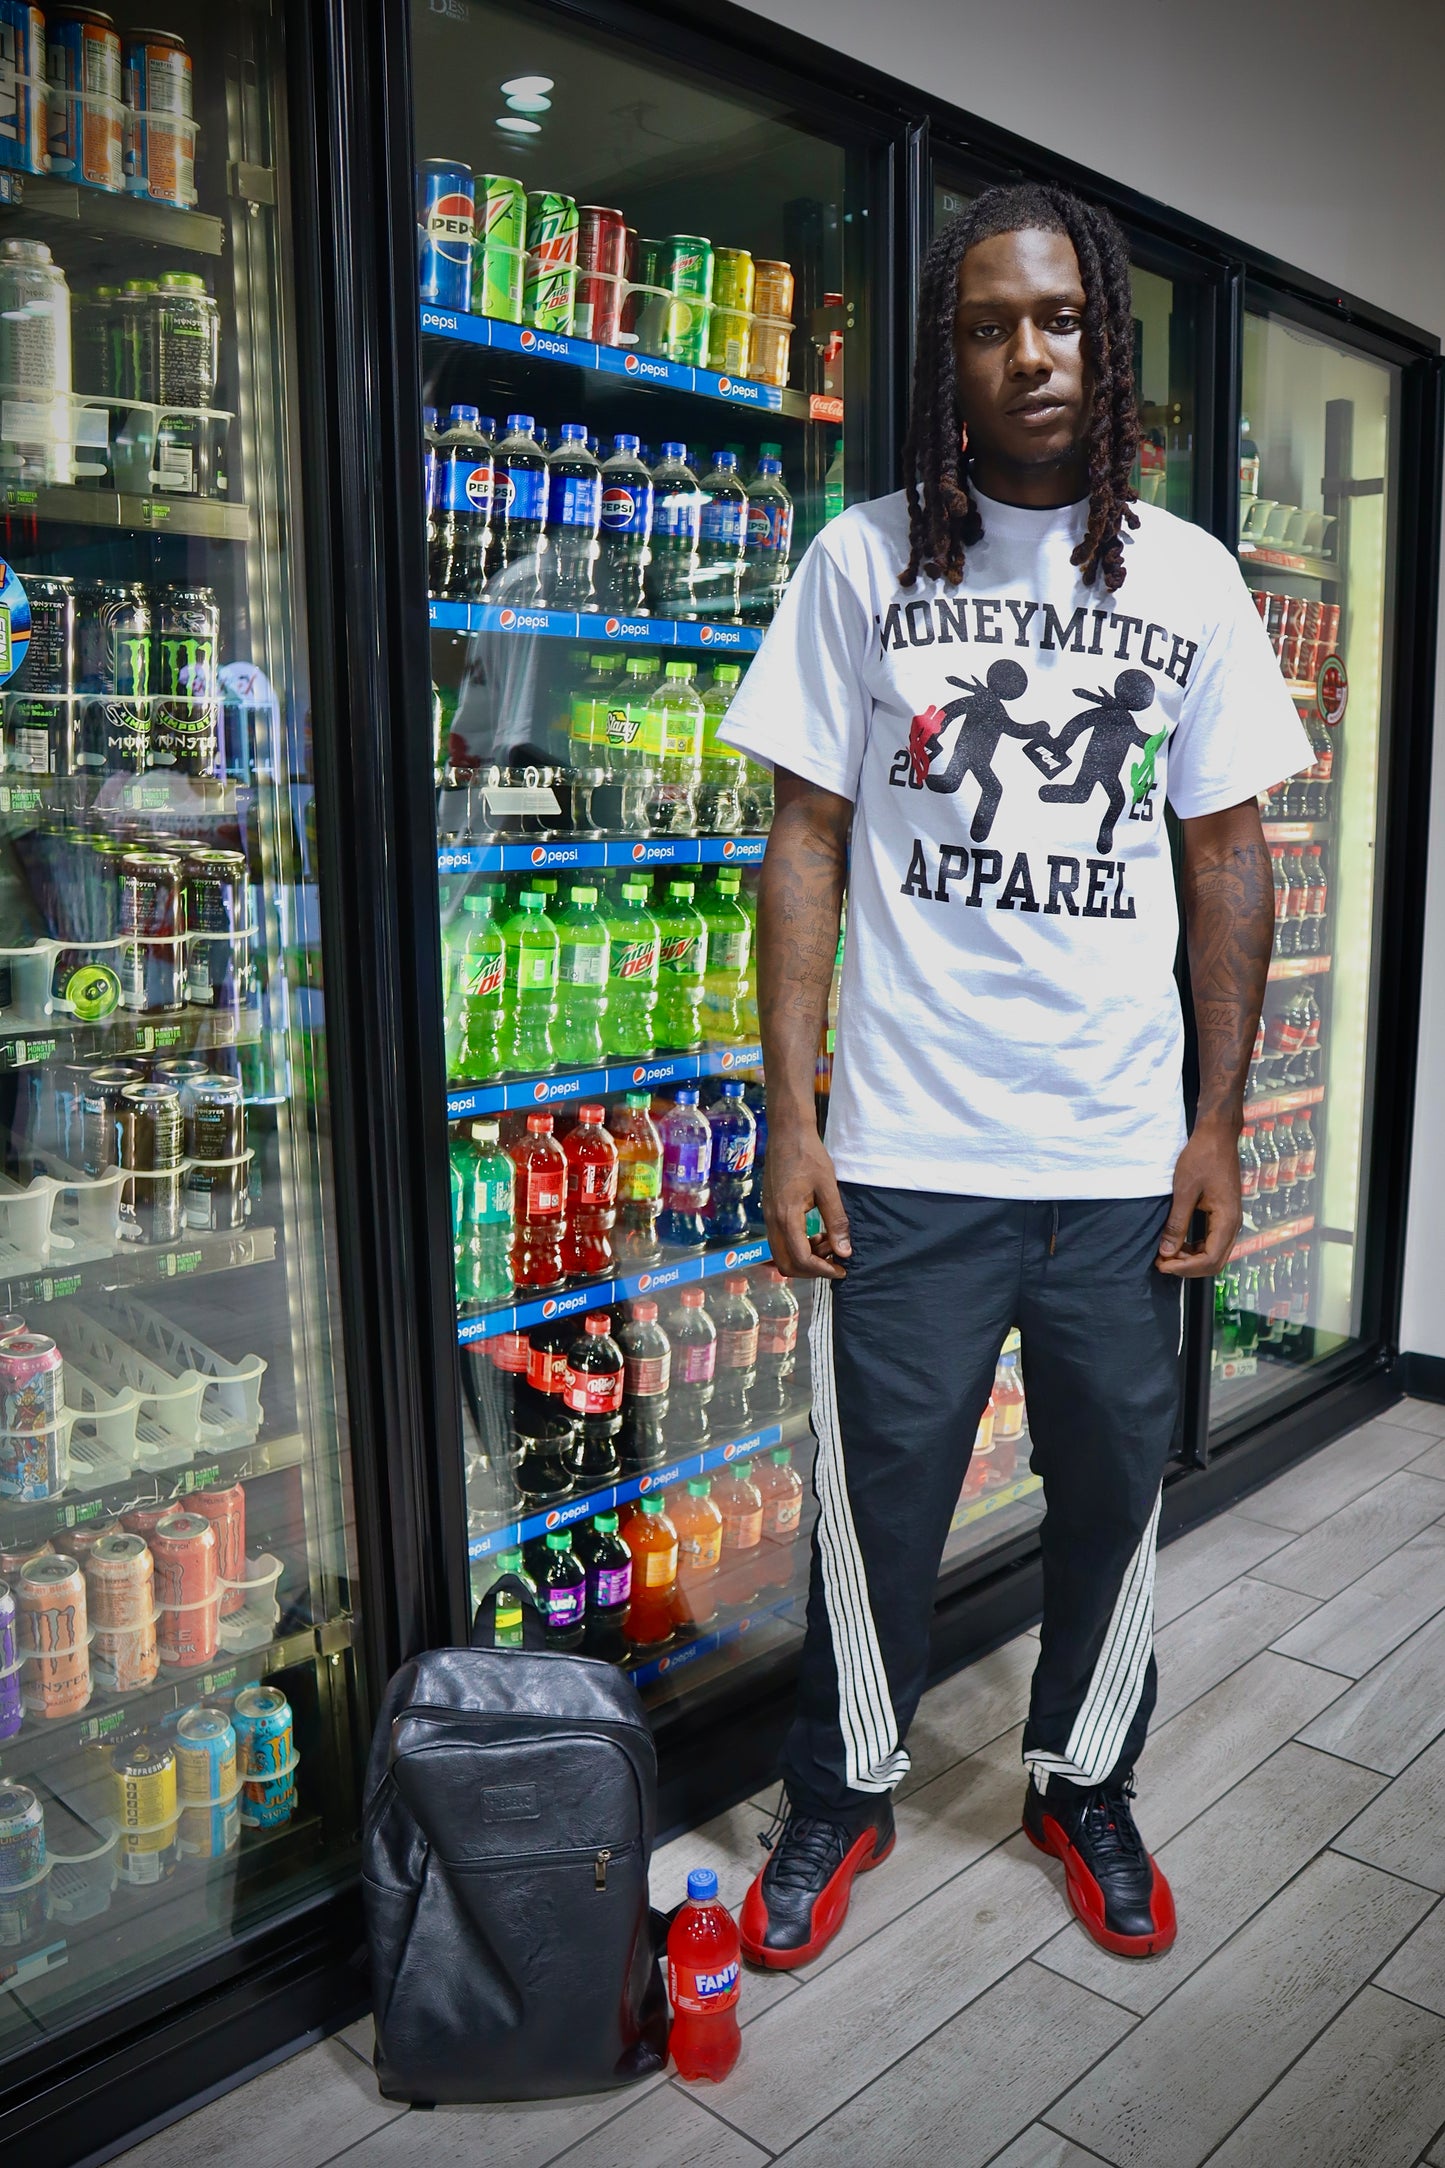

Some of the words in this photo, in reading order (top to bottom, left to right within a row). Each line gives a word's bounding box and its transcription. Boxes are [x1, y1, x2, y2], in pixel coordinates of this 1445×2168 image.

[422, 312, 458, 330] pepsi
[537, 339, 569, 356] pepsi
[640, 363, 669, 378] pepsi
[732, 385, 758, 399] pepsi
[517, 613, 549, 631] pepsi
[620, 622, 649, 638] pepsi
[713, 630, 740, 645] pepsi
[876, 598, 1198, 687] MONEYMITCH
[547, 847, 579, 864] pepsi
[646, 844, 675, 861] pepsi
[735, 841, 763, 857] pepsi
[438, 851, 472, 868] pepsi
[900, 839, 1137, 919] APPAREL
[28, 1043, 56, 1053] MONSTER
[735, 1051, 760, 1067] pepsi
[647, 1065, 675, 1081] pepsi
[549, 1079, 579, 1098] pepsi
[738, 1247, 763, 1265] pepsi
[652, 1269, 680, 1288] pepsi
[558, 1295, 587, 1314] pepsi
[735, 1437, 760, 1456] pepsi
[650, 1468, 679, 1488] pepsi
[561, 1502, 589, 1522] pepsi
[126, 1762, 163, 1776] REFRESH
